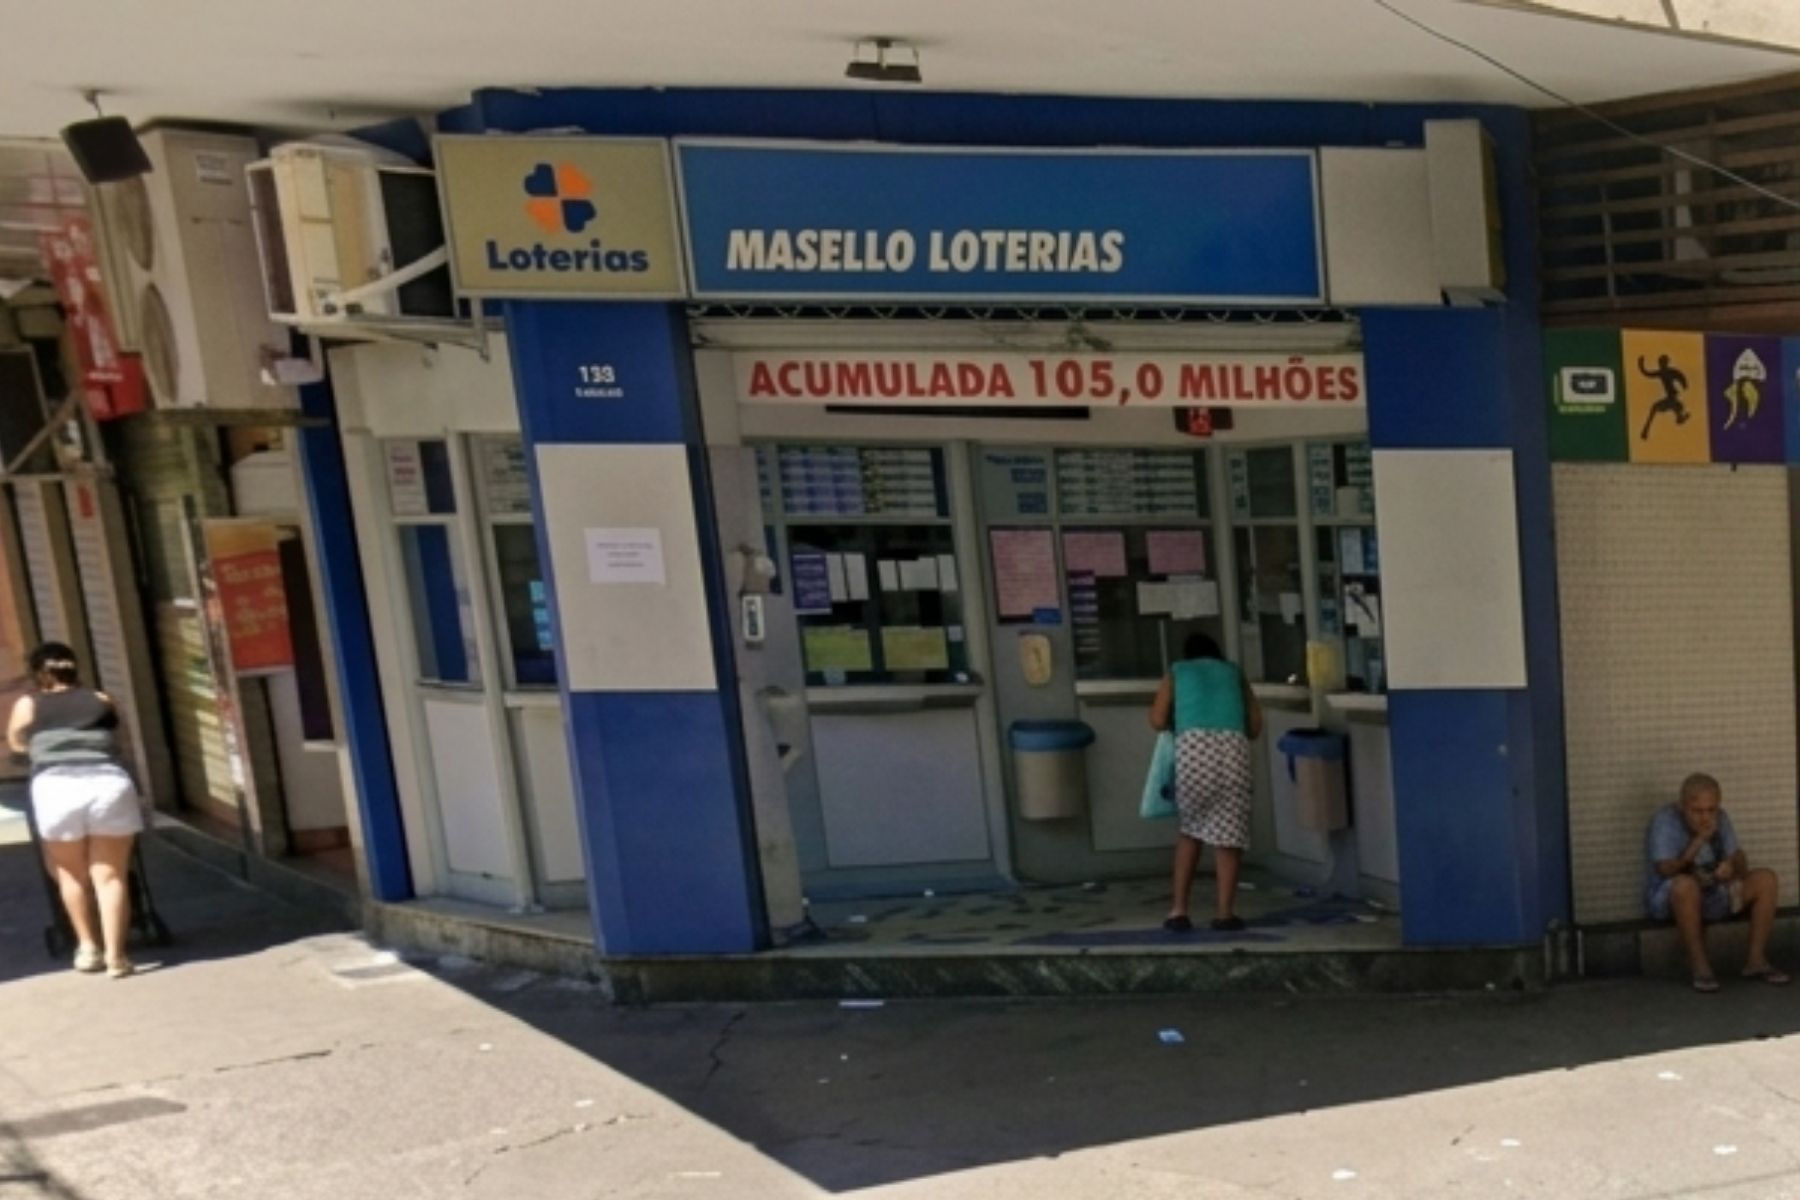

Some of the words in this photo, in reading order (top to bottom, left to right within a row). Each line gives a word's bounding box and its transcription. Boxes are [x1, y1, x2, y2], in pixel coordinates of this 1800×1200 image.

[486, 239, 650, 273] Loterias
[727, 229, 916, 272] MASELLO
[929, 230, 1125, 273] LOTERIAS
[748, 360, 1015, 398] ACUMULADA
[1029, 359, 1164, 406] 105,0
[1179, 356, 1359, 401] MILHÕES
